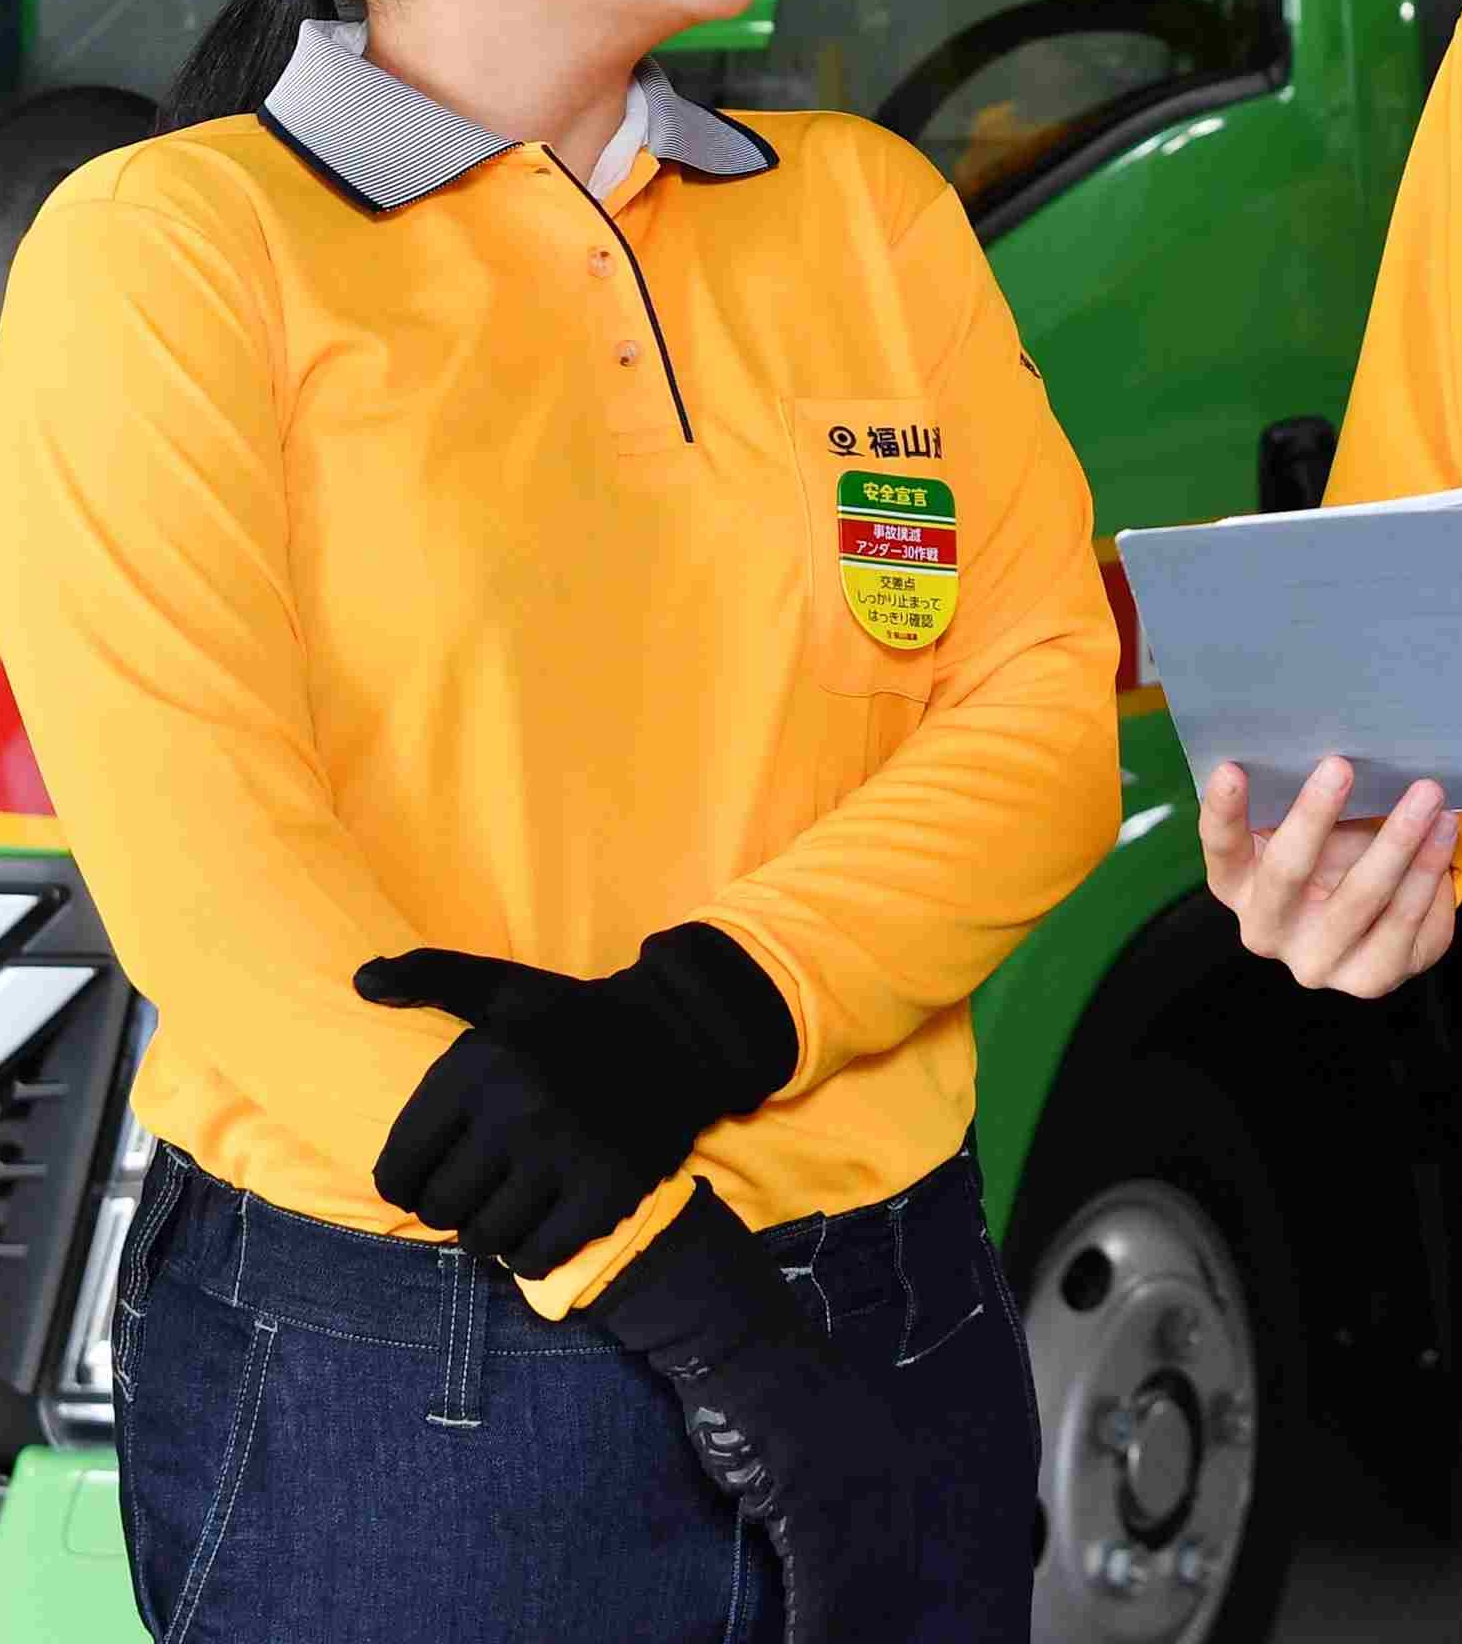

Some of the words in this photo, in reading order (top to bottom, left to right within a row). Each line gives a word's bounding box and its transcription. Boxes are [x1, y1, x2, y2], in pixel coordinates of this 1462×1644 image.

[862, 482, 927, 507] 安全宣言
[855, 540, 939, 562] アンダー30作戦
[880, 575, 916, 590] 交差点
[857, 590, 942, 610] しっかり止まって
[868, 610, 934, 629] はっきり確認
